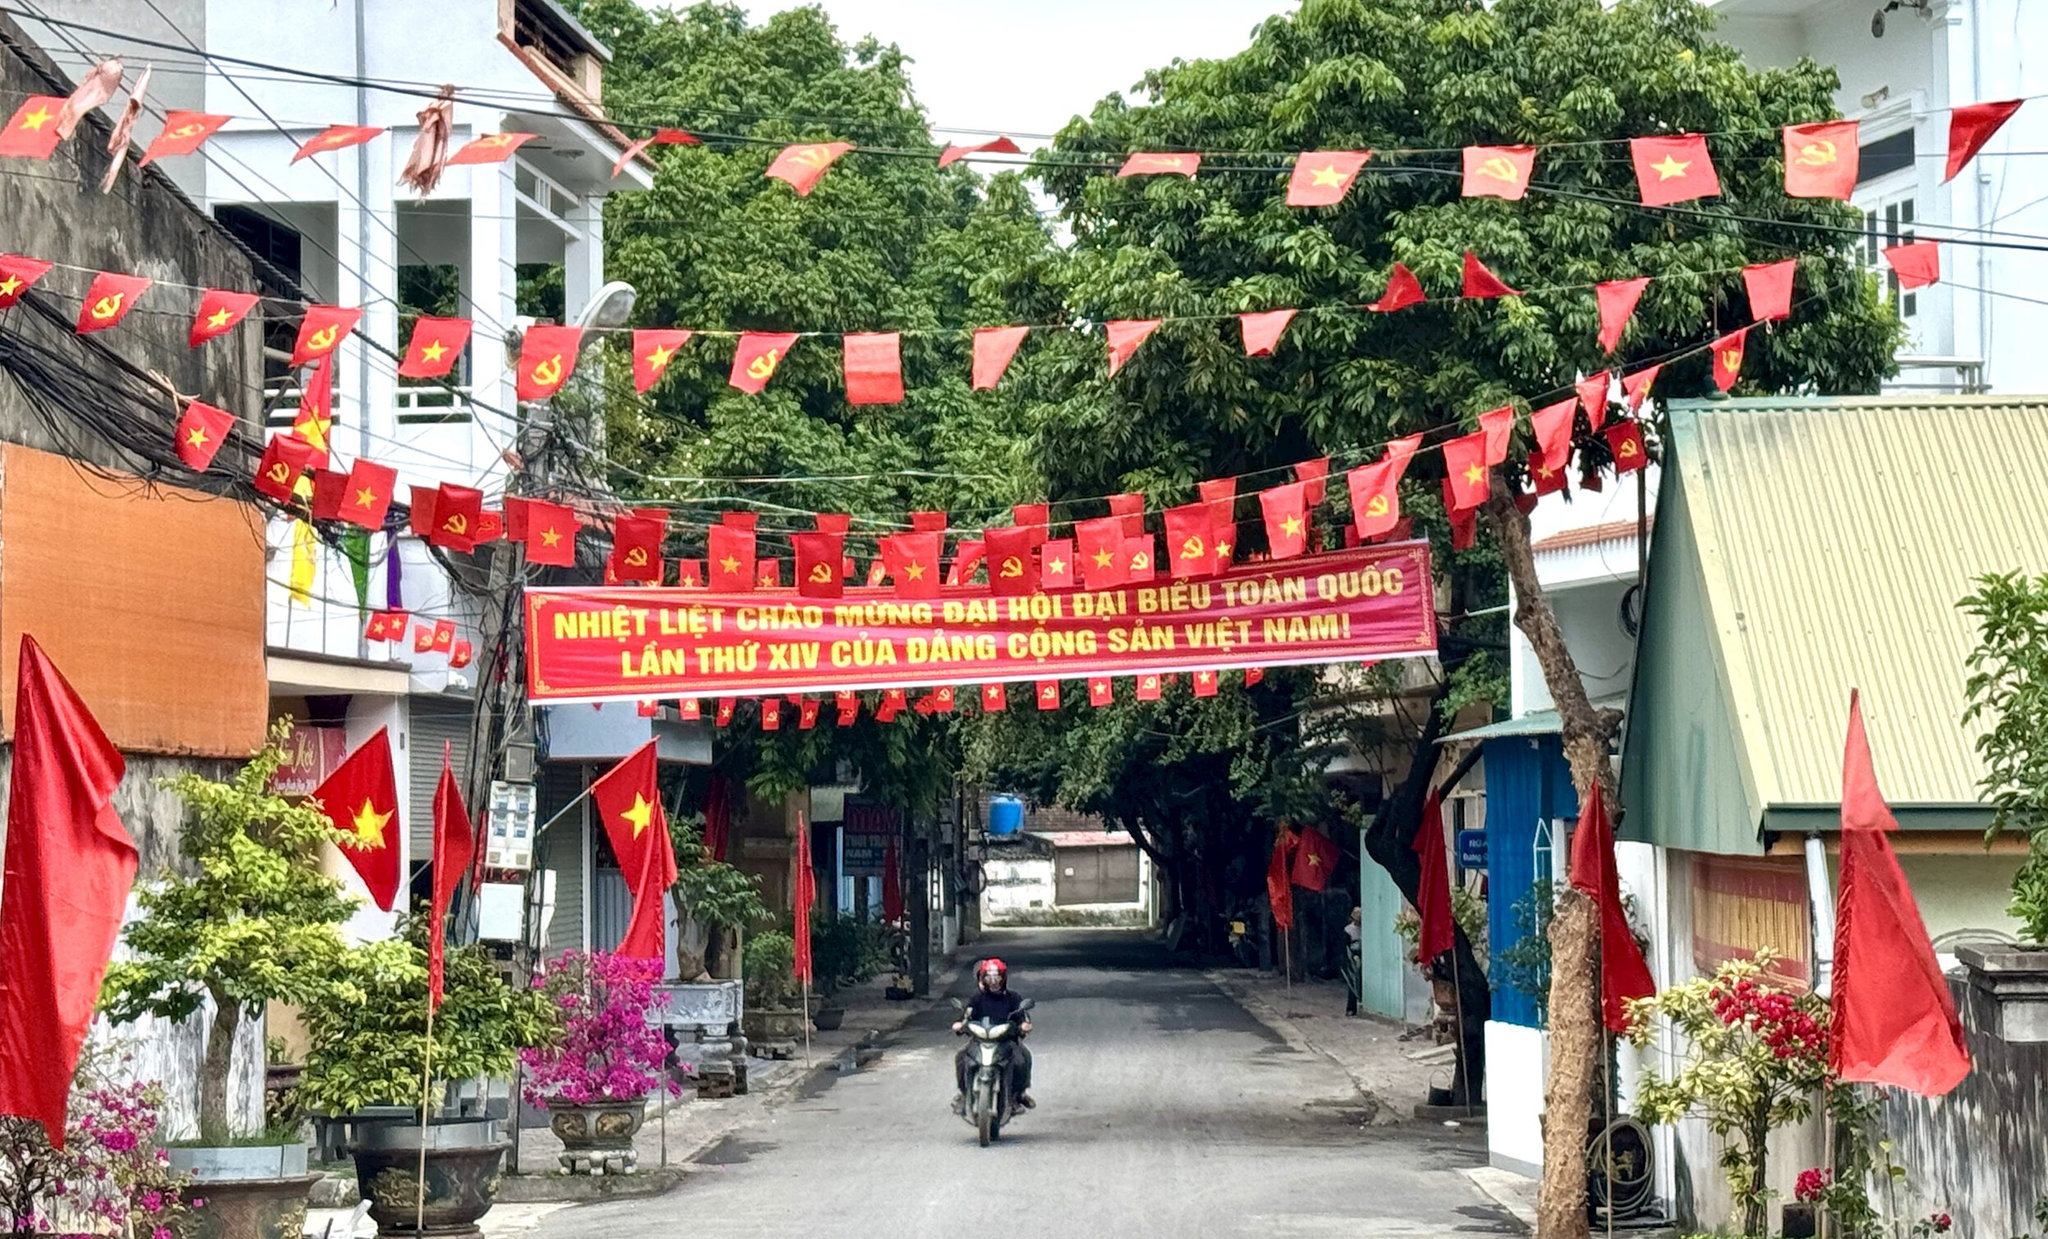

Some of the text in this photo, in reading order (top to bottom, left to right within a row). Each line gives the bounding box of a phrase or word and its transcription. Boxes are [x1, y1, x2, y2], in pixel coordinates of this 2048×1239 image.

[554, 560, 1404, 643] NHIỆT LIỆT CHÀO MỪNG ĐẠI HỘI ĐẠI BIỂU TOÀN QUỐC
[621, 612, 1351, 678] LẦN THỨ XIV CỦA ĐẢNG CỘNG SẢN VIỆT NAM!
